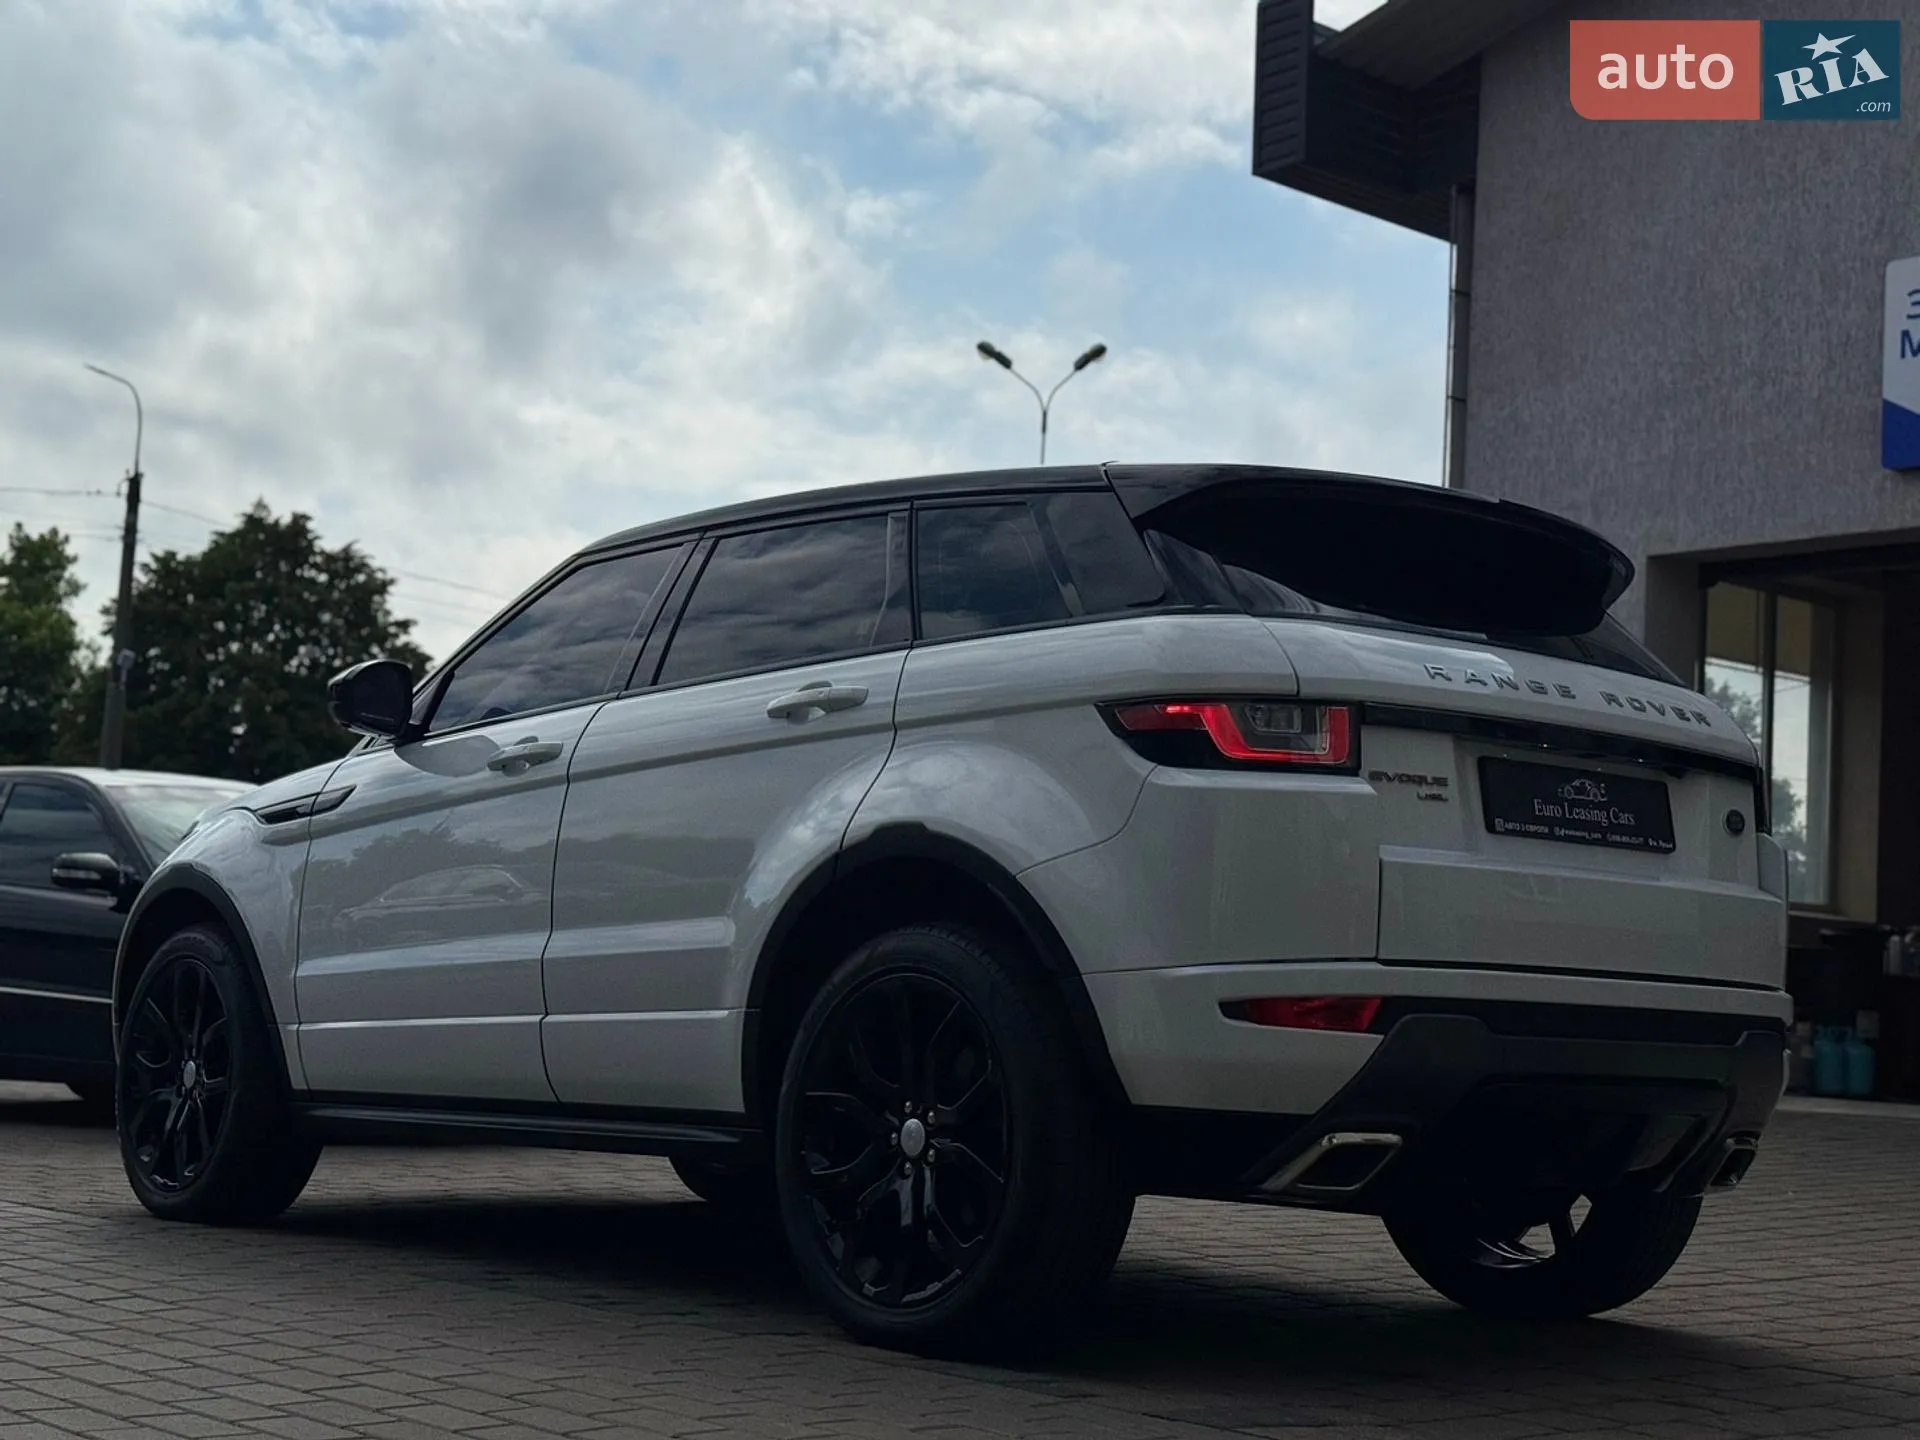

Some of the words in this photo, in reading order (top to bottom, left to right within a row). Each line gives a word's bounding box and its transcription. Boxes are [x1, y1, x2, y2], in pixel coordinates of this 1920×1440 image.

[1423, 663, 1577, 700] RANGE
[1599, 690, 1712, 728] ROVER
[1367, 769, 1449, 787] EVOQUE
[1533, 799, 1563, 819] Euro
[1564, 801, 1608, 826] Leasing
[1609, 807, 1636, 826] Cars
